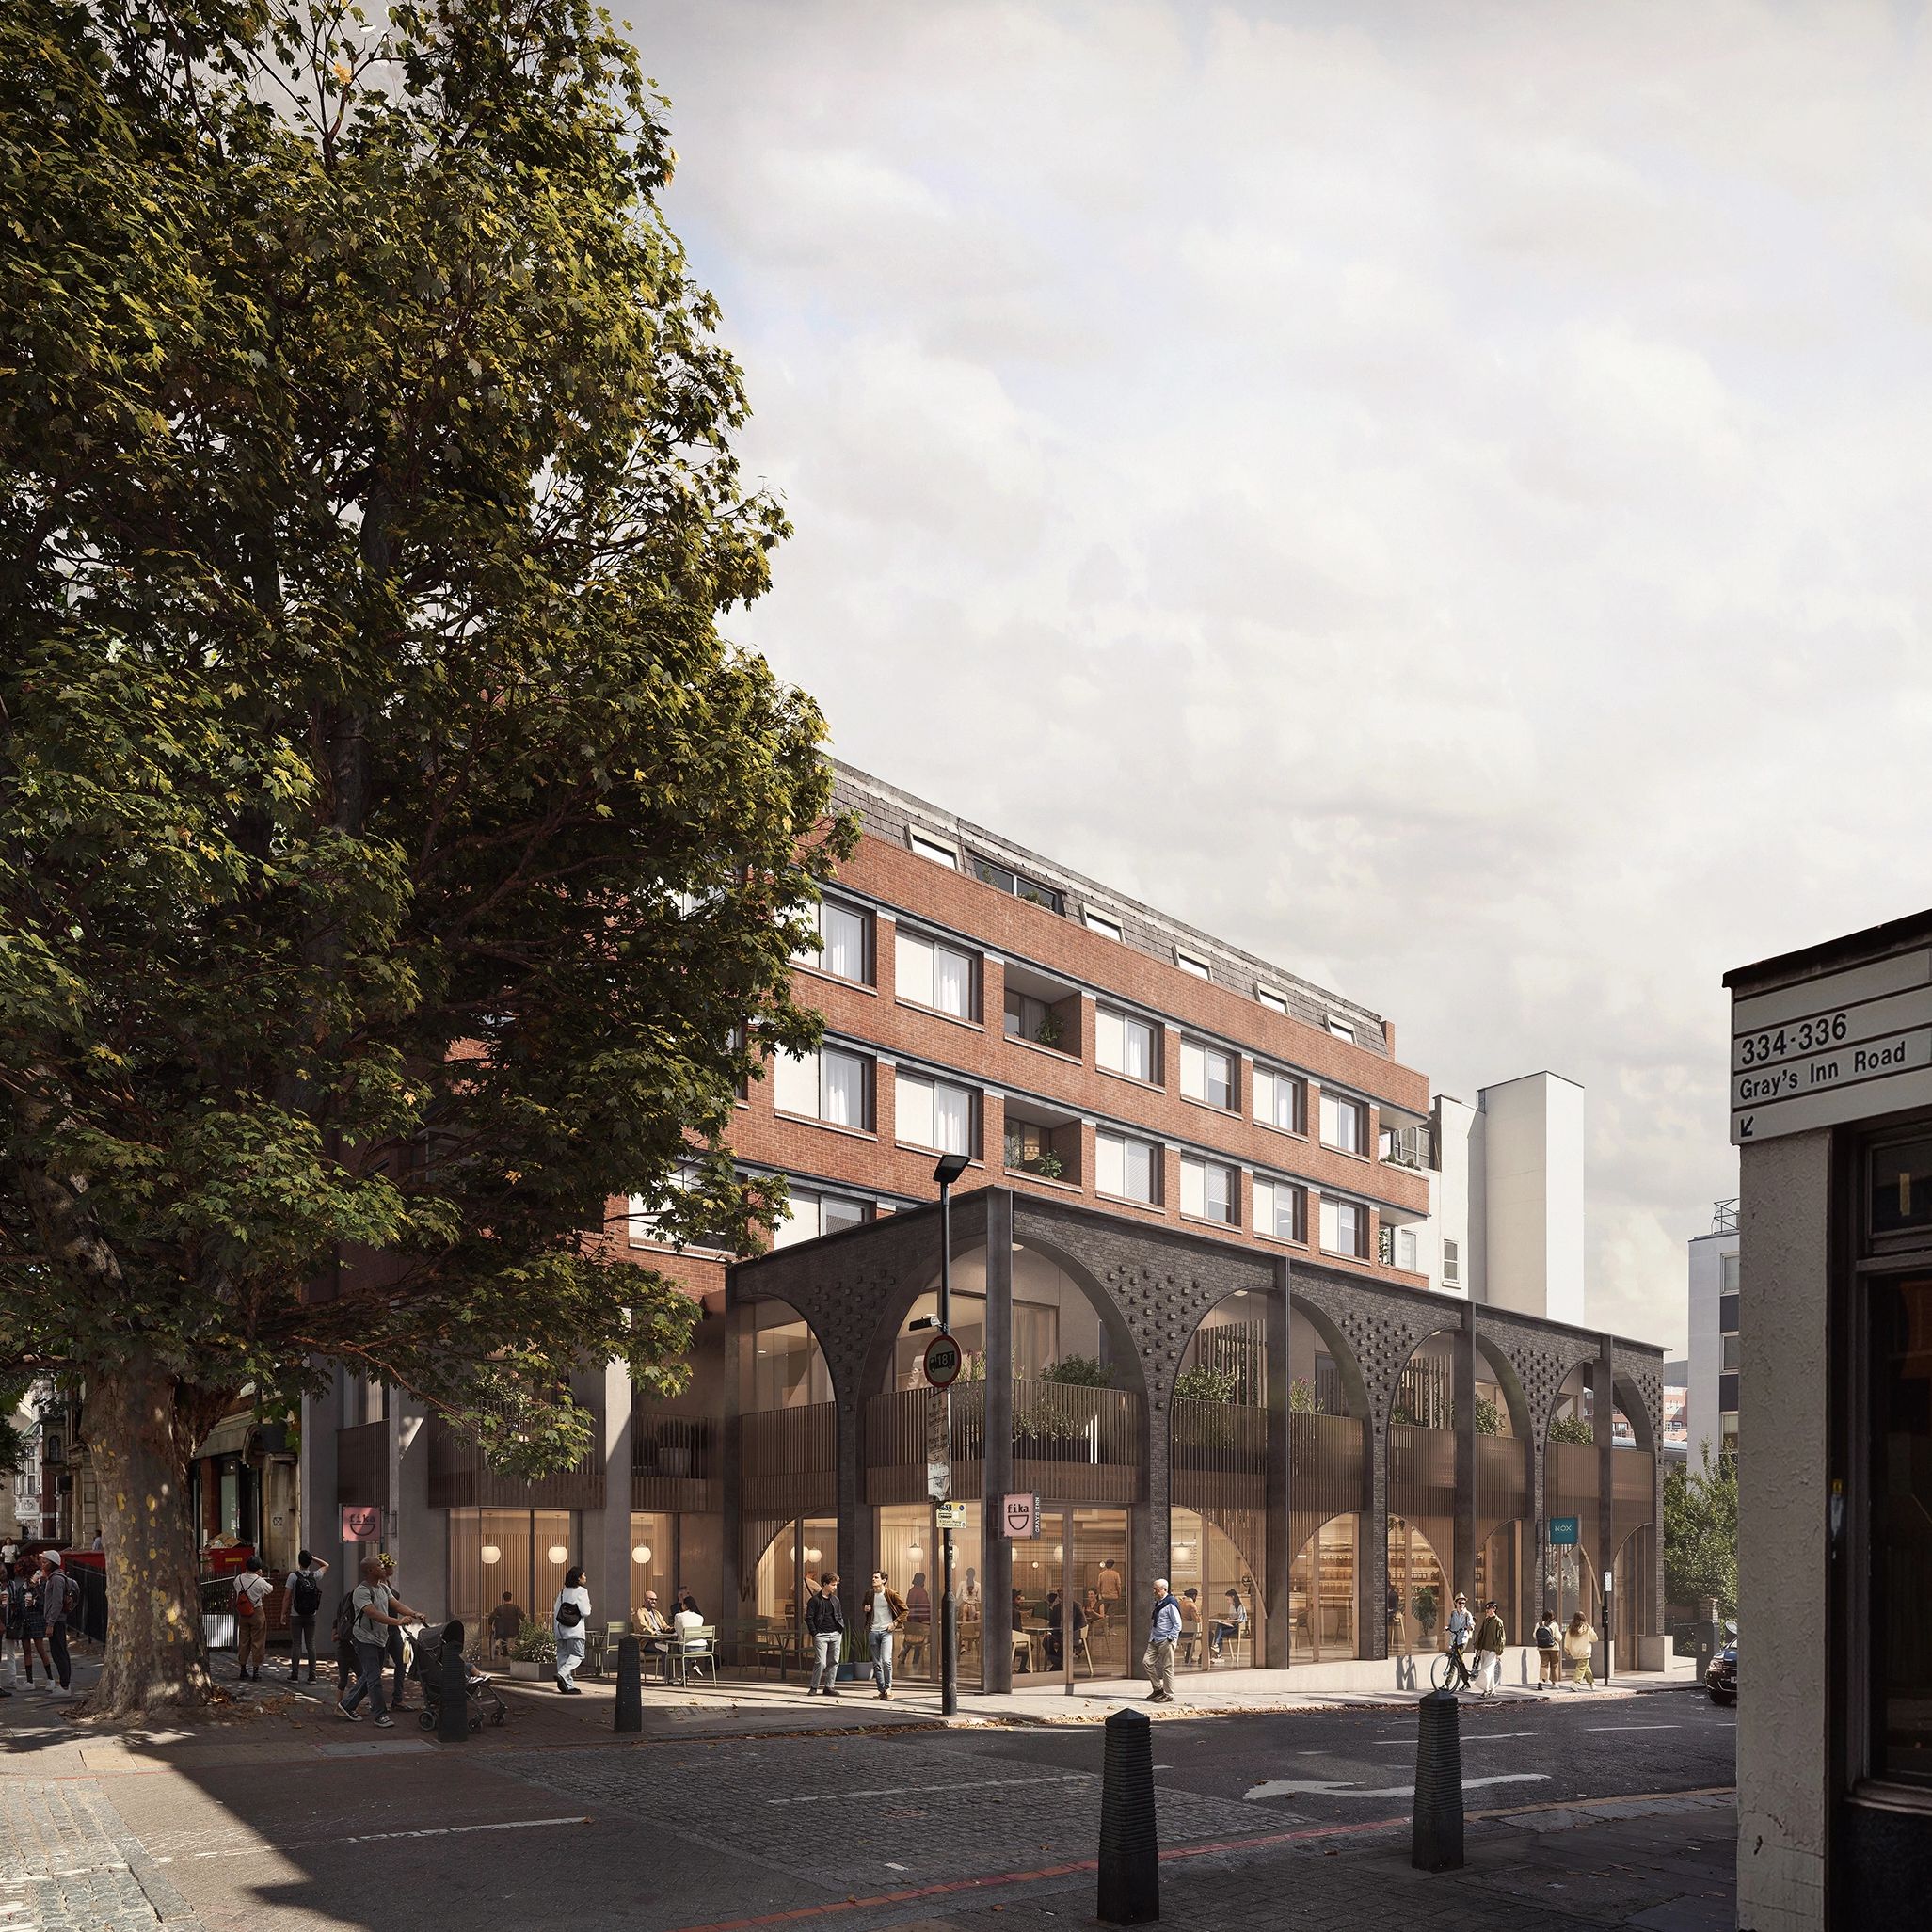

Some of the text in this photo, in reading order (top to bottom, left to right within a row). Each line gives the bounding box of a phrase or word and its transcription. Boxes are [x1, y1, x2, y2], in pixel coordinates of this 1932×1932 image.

[1740, 1041, 1906, 1100] Gray's Inn Road
[1007, 1504, 1030, 1513] fika
[349, 1513, 375, 1523] fika
